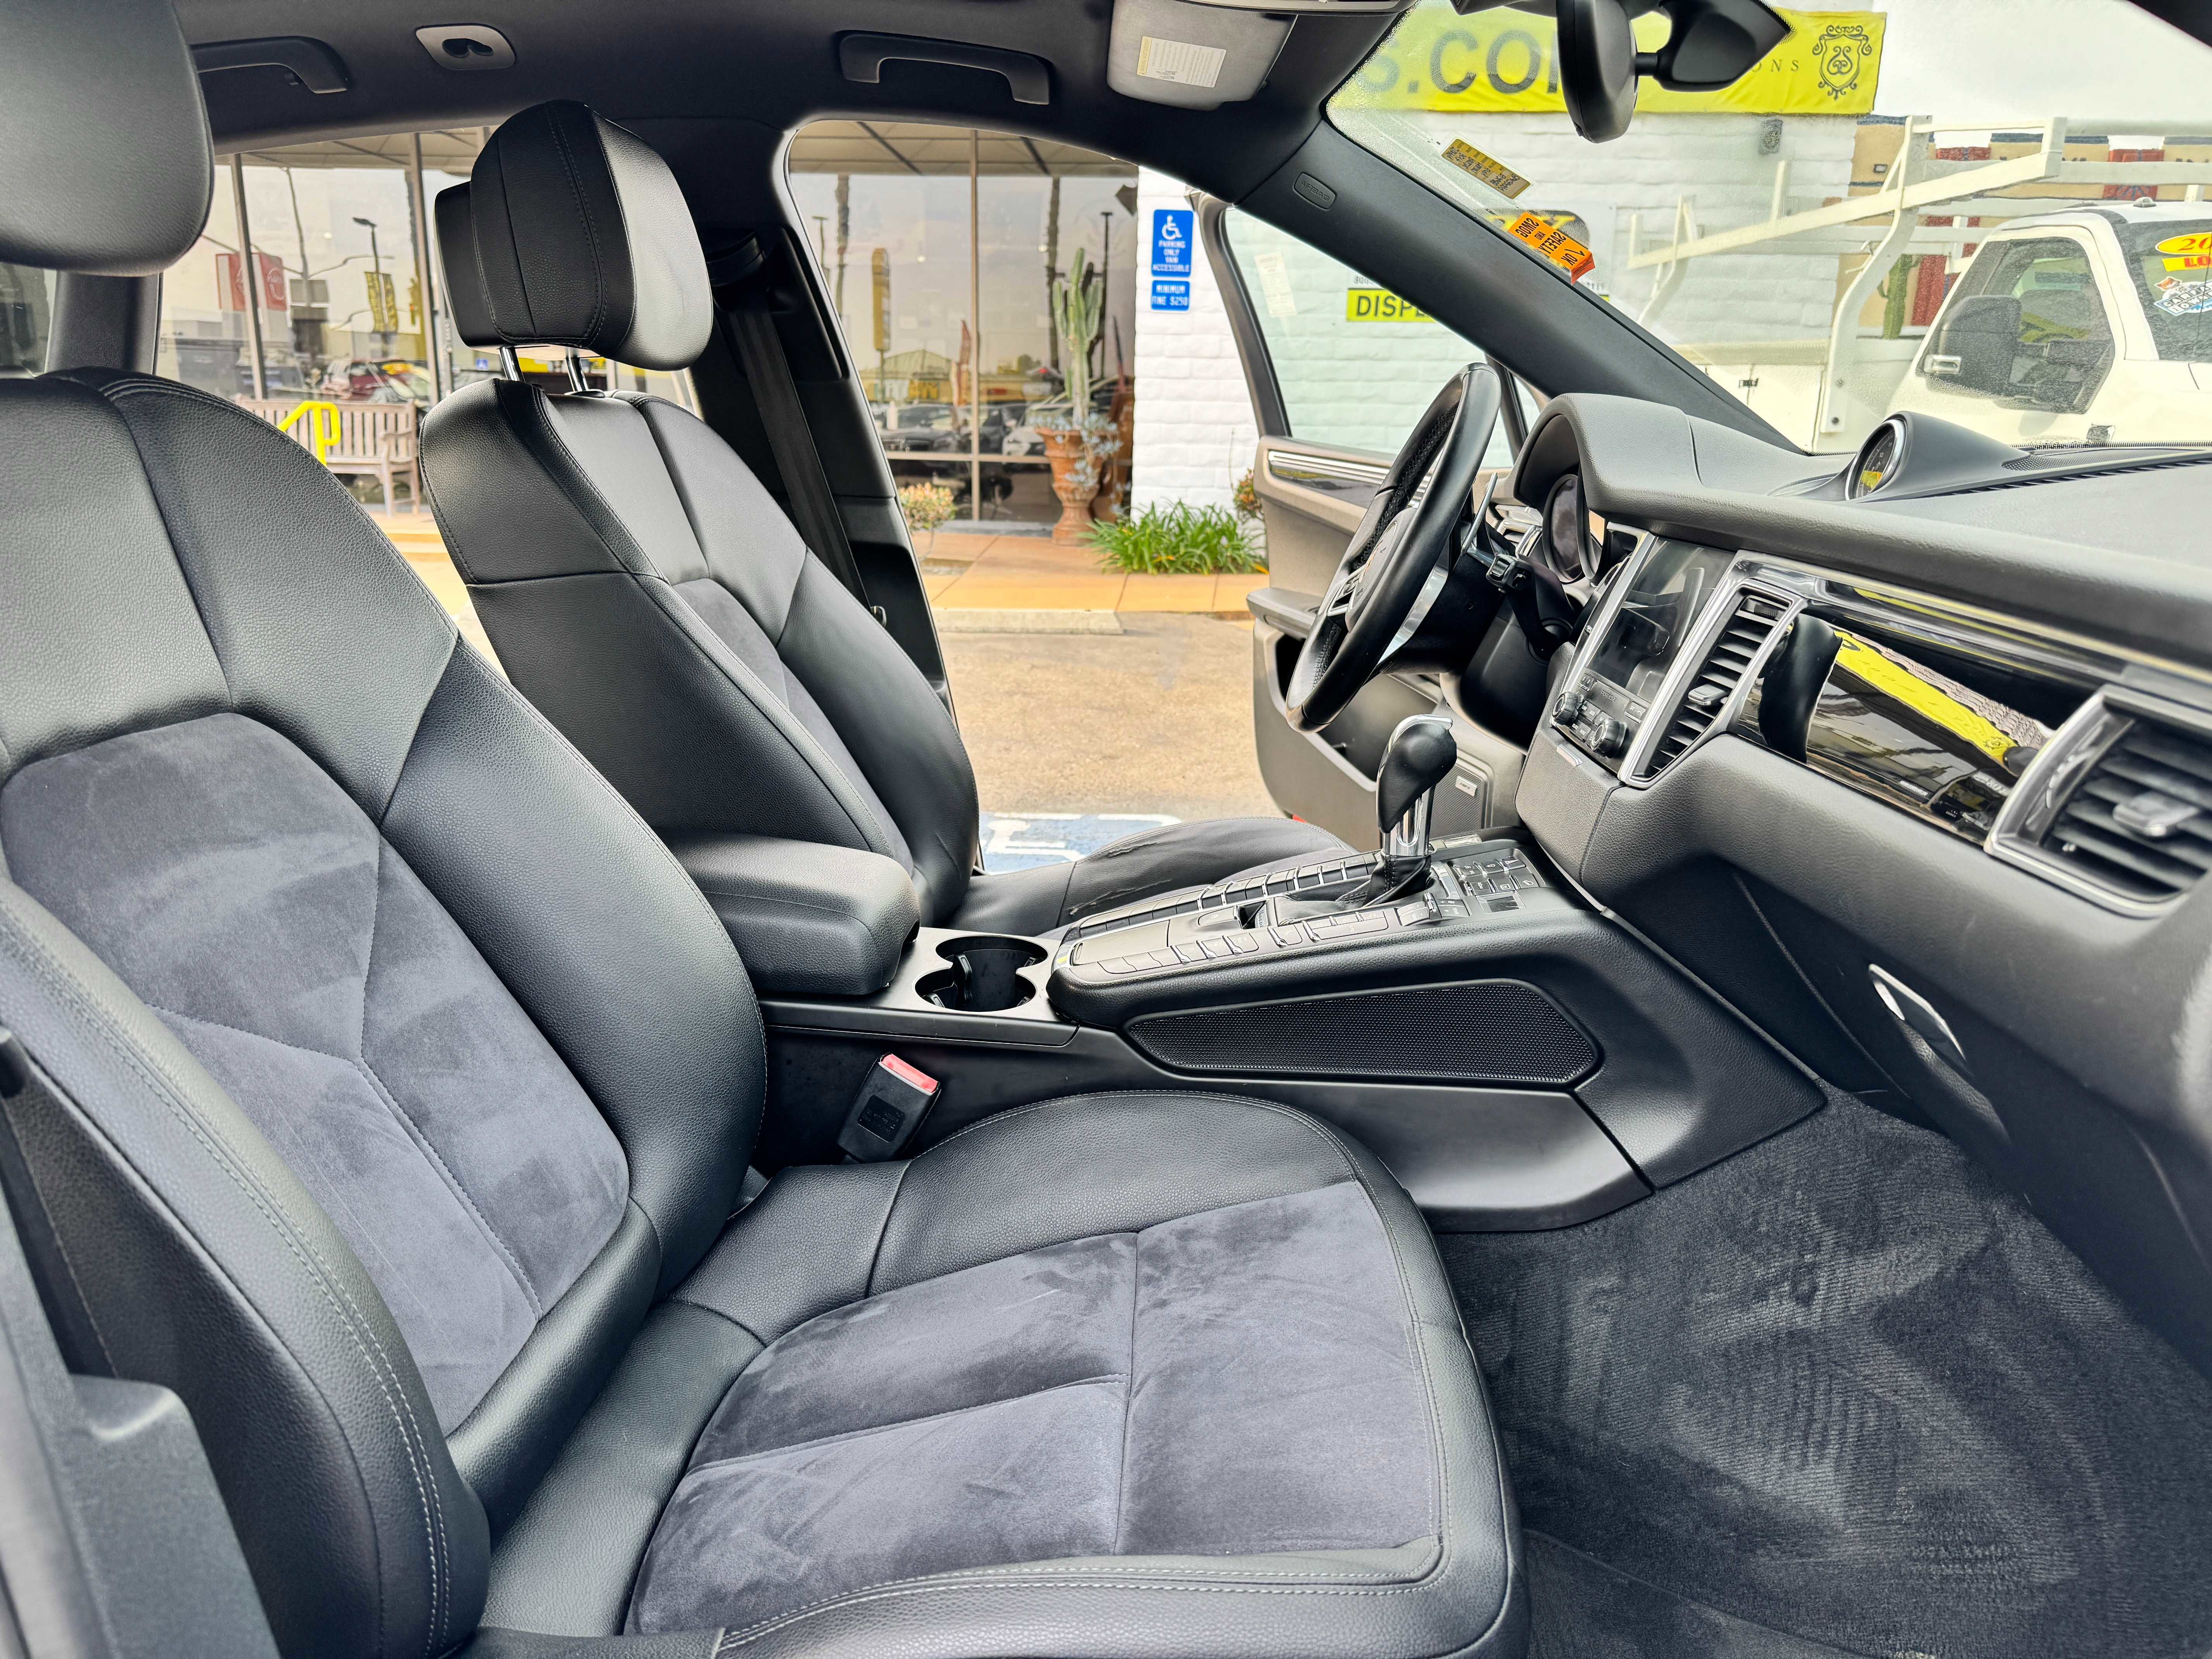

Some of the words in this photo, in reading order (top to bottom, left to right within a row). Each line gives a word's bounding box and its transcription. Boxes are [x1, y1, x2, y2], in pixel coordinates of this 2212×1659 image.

[1301, 180, 1330, 202] AIRBAG
[1158, 240, 1186, 249] PARKING
[1152, 264, 1190, 272] ACCESSIBLE
[1156, 285, 1186, 294] MINIMUM
[1152, 296, 1166, 305] FINE
[1170, 296, 1189, 306] $250
